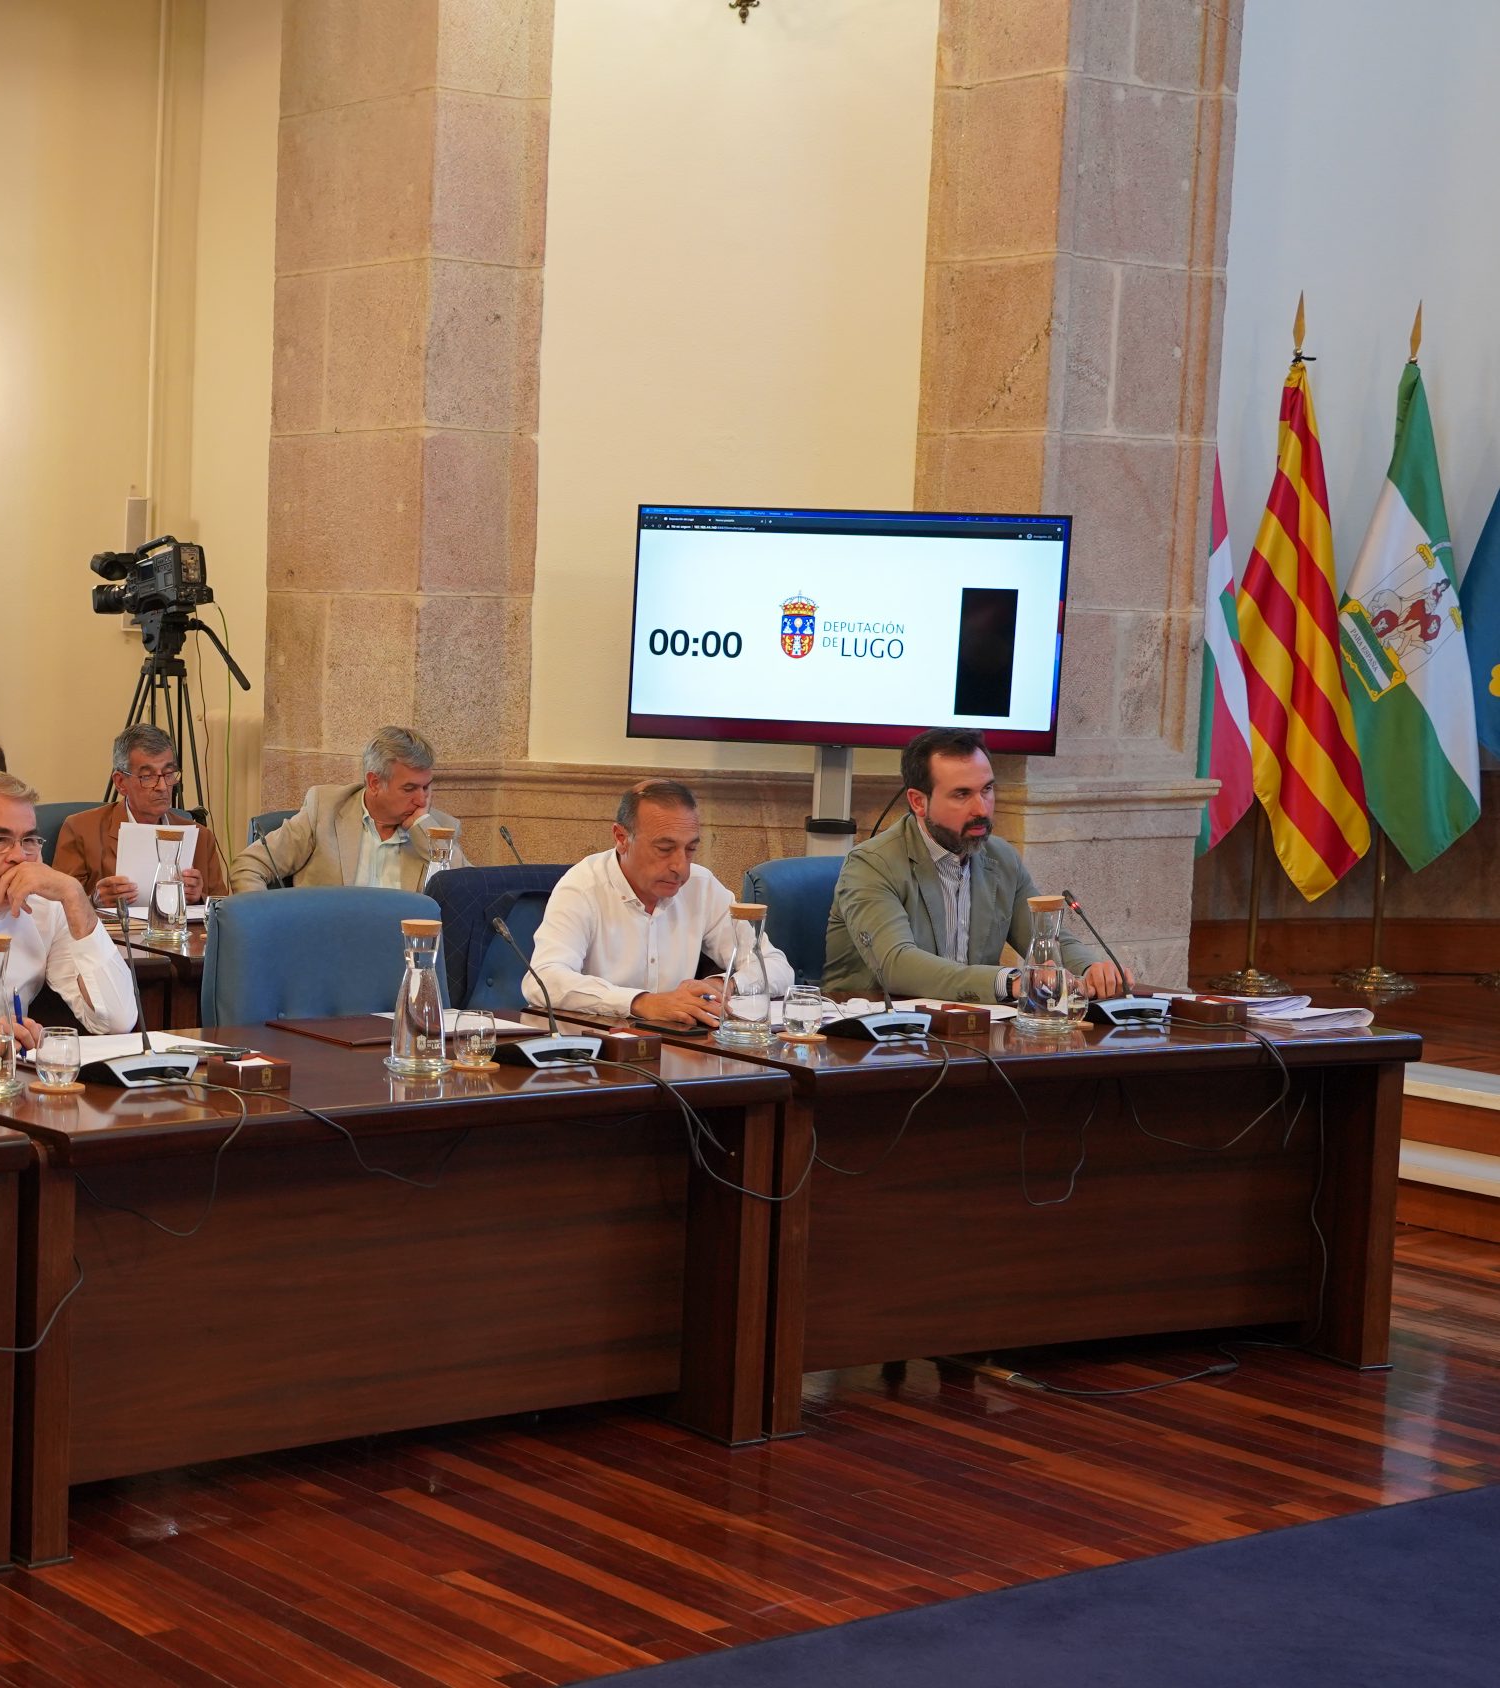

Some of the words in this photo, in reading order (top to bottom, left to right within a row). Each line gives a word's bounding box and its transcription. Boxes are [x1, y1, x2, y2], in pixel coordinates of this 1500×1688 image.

[823, 621, 905, 635] DEPUTACIÓN
[1350, 628, 1363, 647] PARA
[649, 628, 743, 659] 00:00
[822, 636, 839, 648] DE
[840, 638, 905, 659] LUGO
